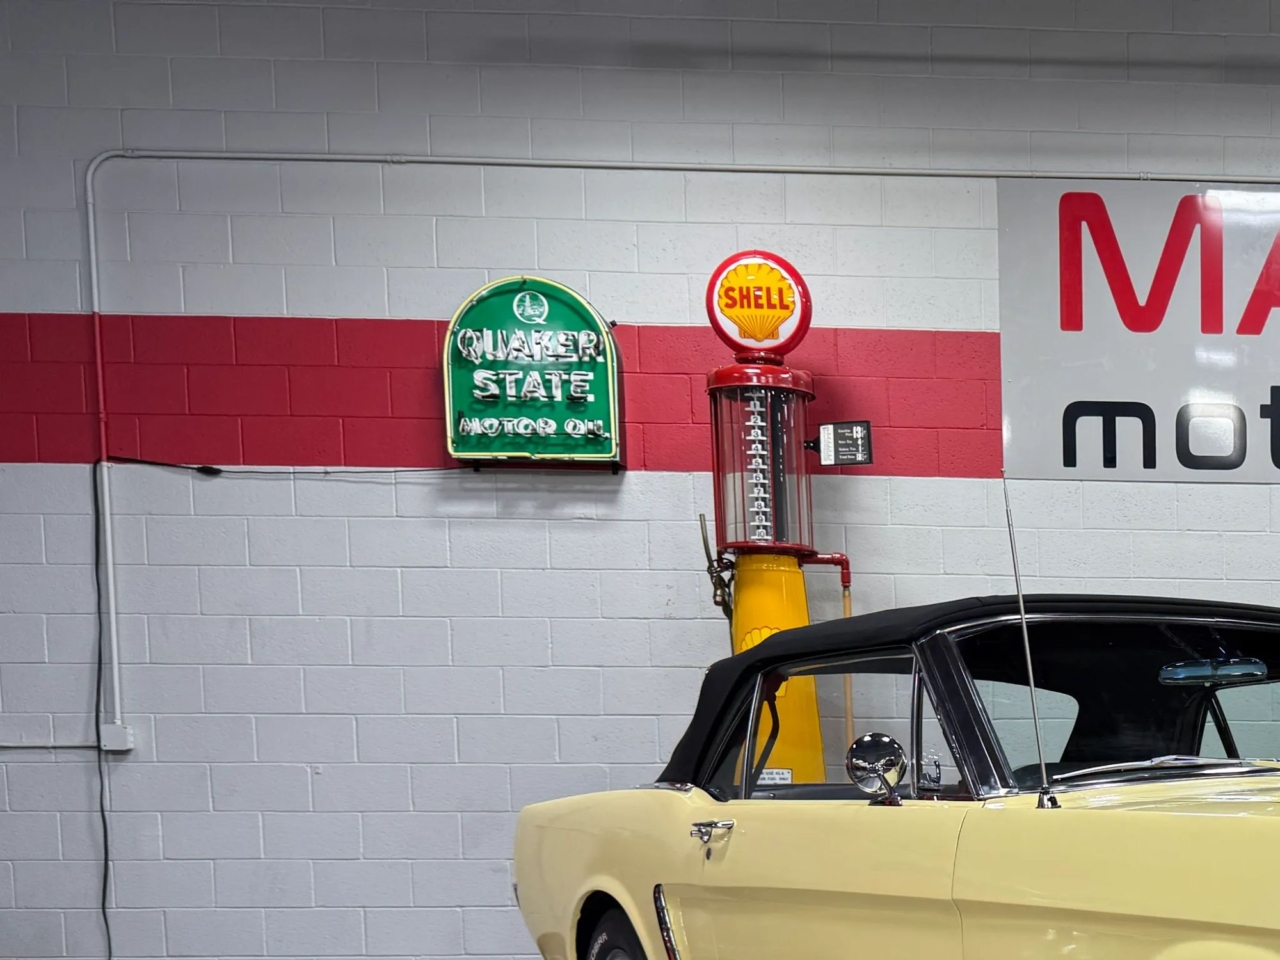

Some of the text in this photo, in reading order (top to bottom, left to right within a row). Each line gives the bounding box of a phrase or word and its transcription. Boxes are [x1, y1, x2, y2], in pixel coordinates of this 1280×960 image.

[724, 286, 790, 310] SHELL
[457, 328, 605, 365] QUAKER
[473, 369, 595, 402] STATE
[459, 416, 609, 438] MOTOR OIL
[757, 530, 765, 538] 10
